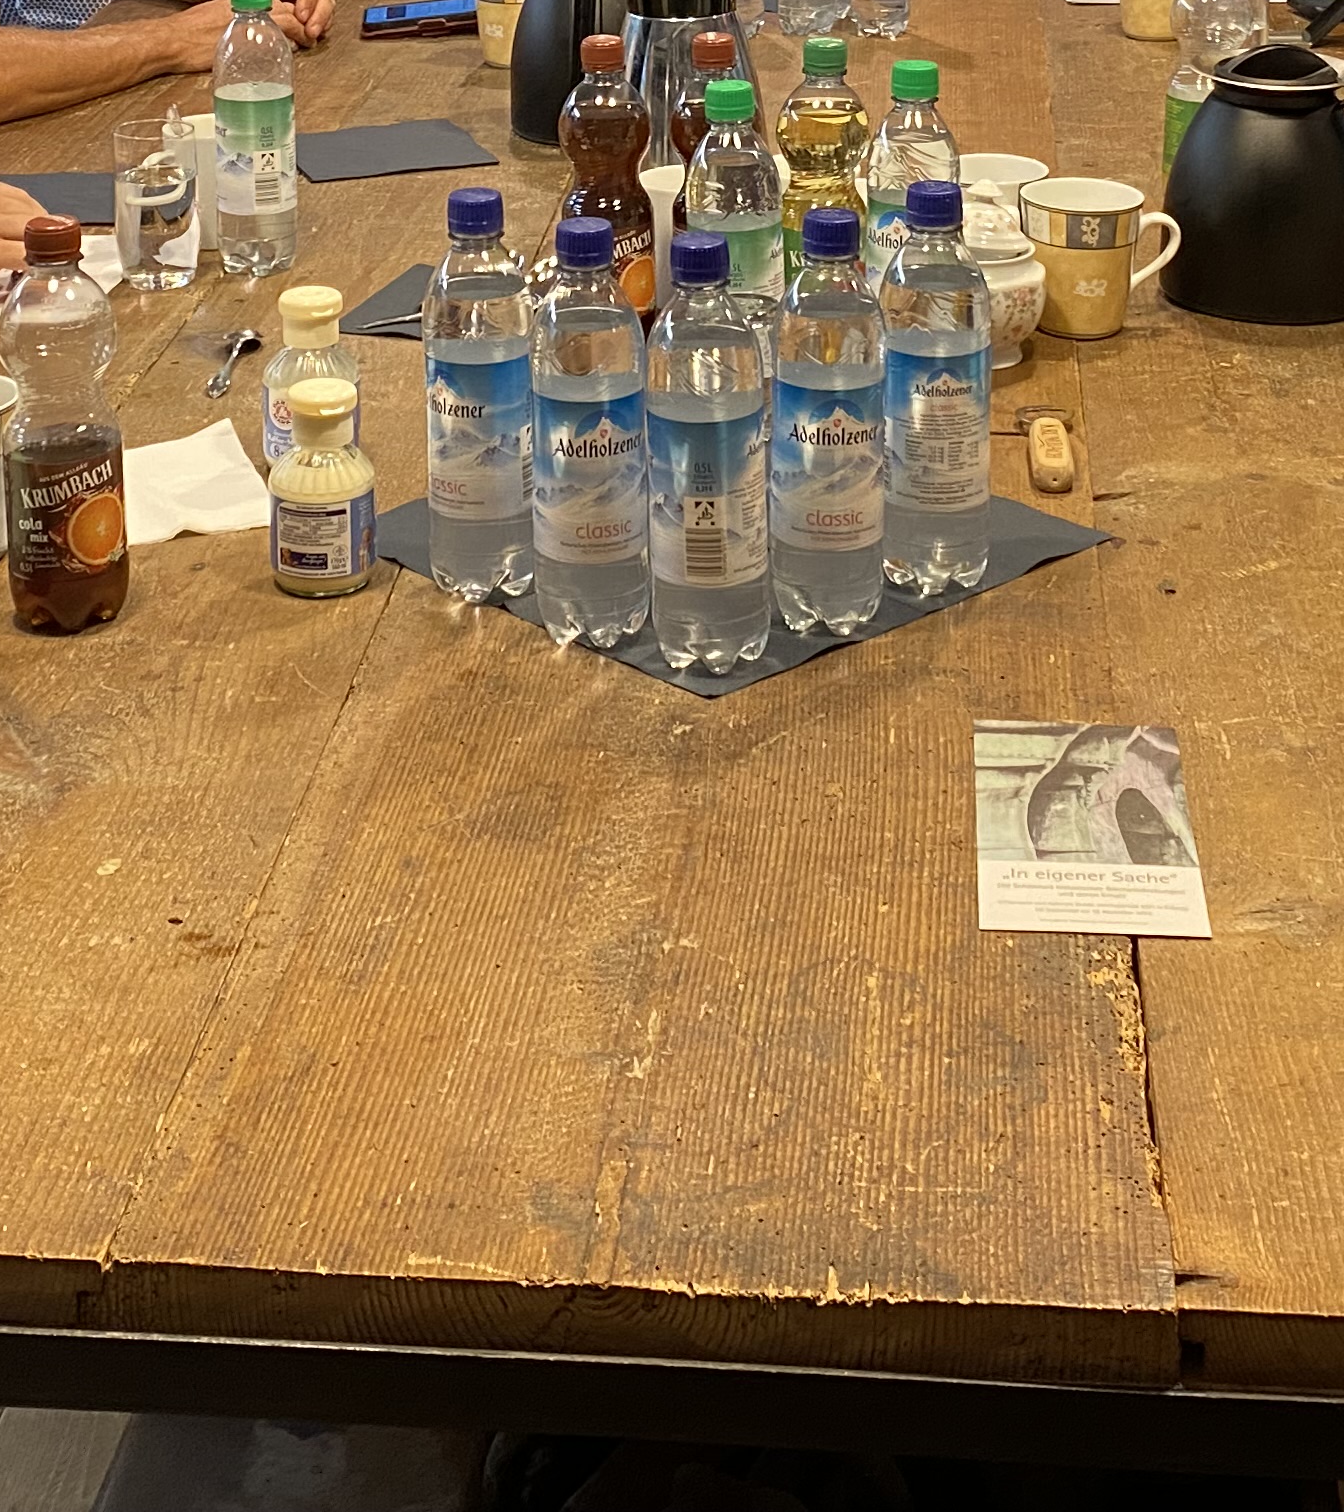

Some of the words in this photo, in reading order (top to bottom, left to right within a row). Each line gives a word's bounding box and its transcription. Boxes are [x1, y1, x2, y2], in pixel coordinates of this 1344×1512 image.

[612, 229, 652, 260] MBACH
[868, 226, 904, 249] Adelhol
[429, 398, 486, 419] lholzener
[552, 431, 643, 459] Adelholzener
[787, 423, 879, 447] Adelholzener
[20, 459, 114, 509] KRUMBACH
[18, 517, 43, 531] cola
[806, 509, 864, 527] classic
[29, 532, 49, 543] mix
[575, 520, 633, 540] classic
[1035, 871, 1108, 884] eigener
